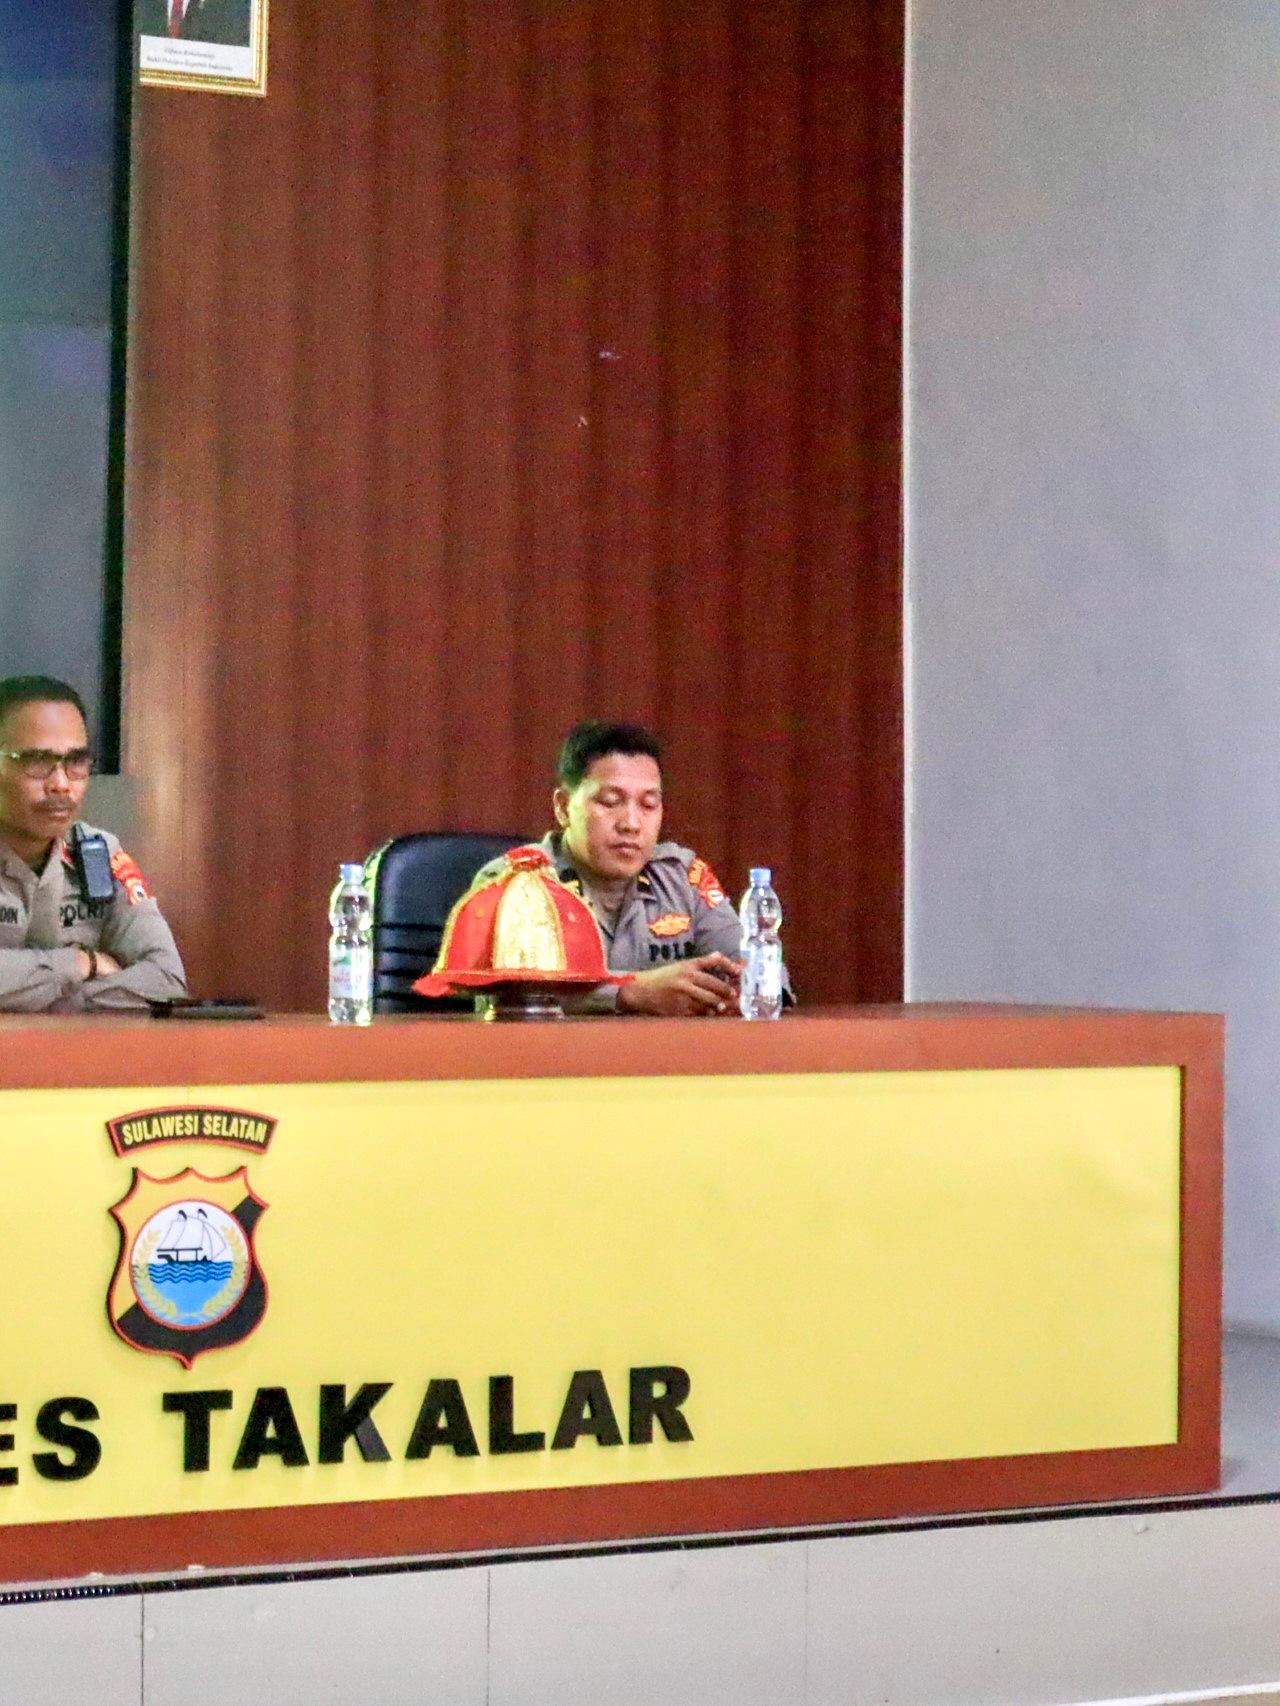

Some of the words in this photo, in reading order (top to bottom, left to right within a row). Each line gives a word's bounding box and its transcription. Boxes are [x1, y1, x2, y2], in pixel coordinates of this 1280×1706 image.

[121, 1114, 200, 1146] SULAWESI
[202, 1113, 269, 1144] SELATAN
[161, 1366, 696, 1473] TAKALAR
